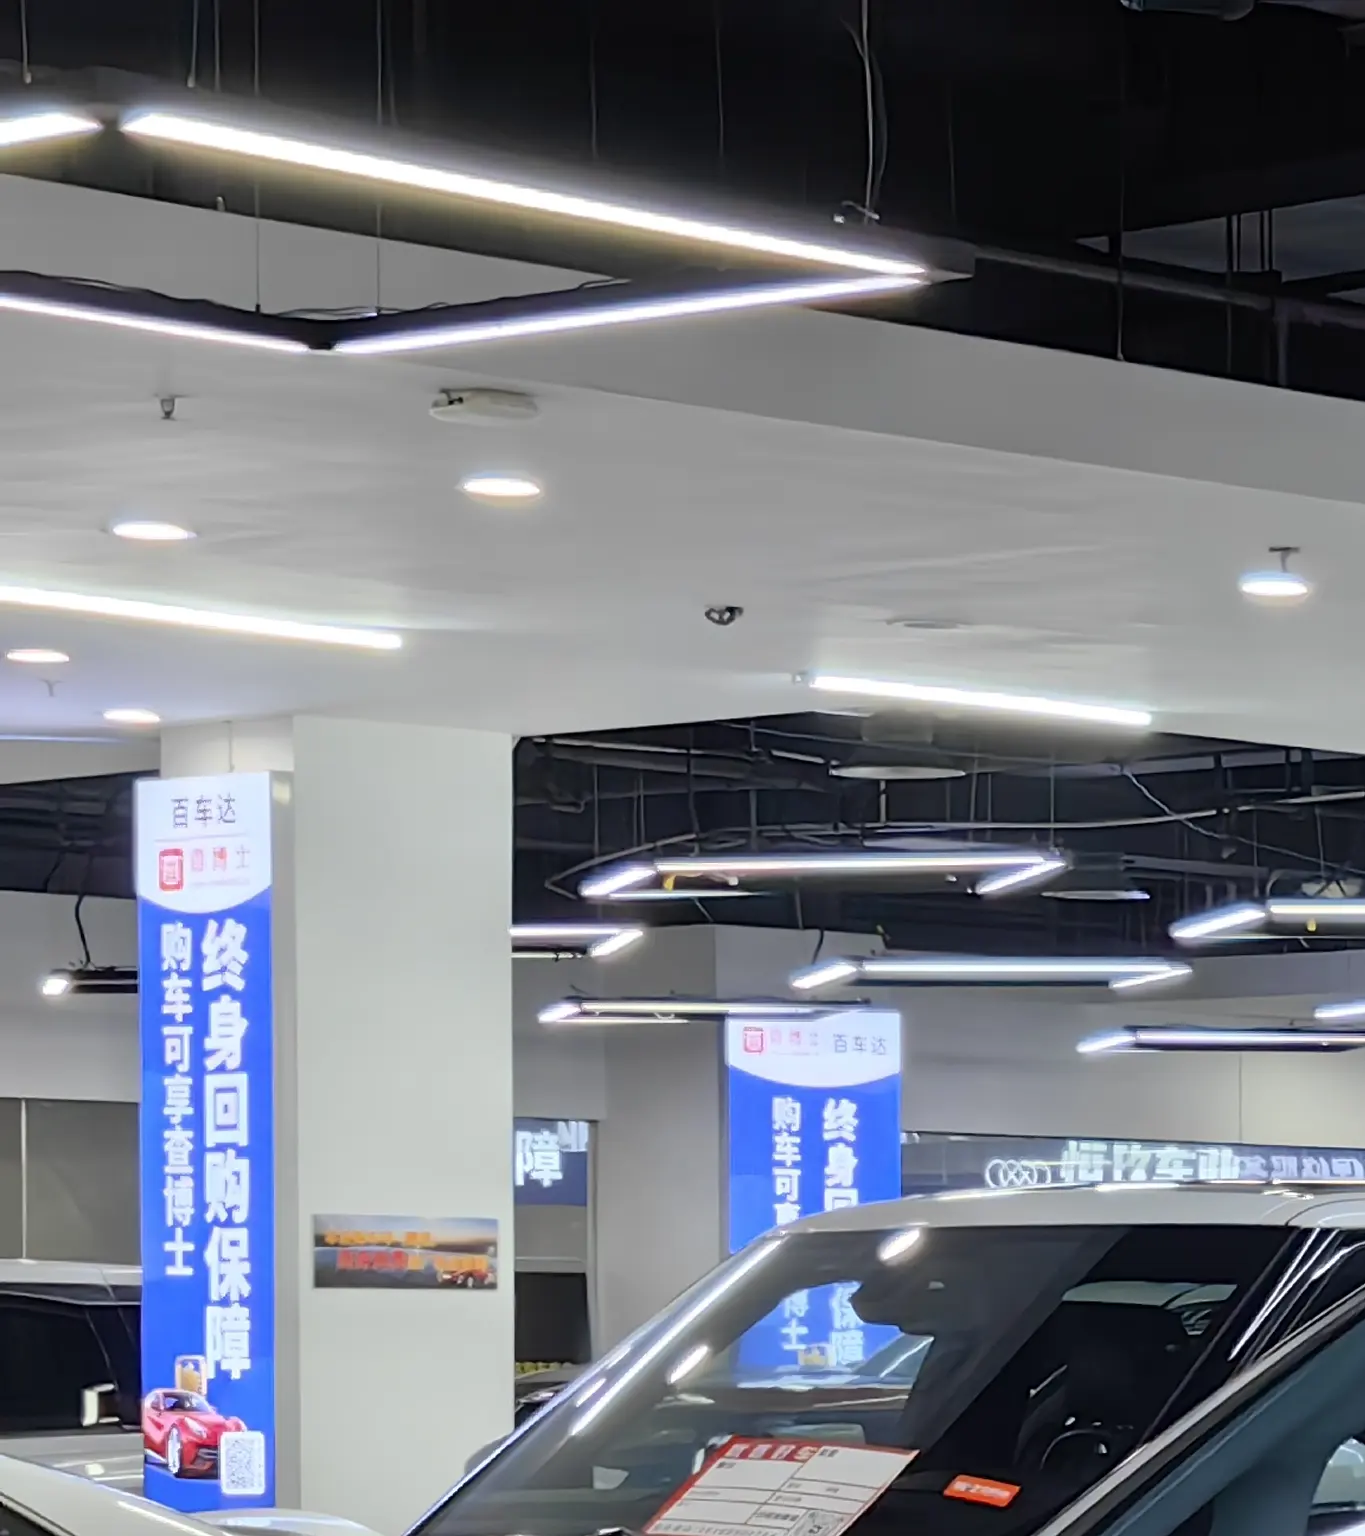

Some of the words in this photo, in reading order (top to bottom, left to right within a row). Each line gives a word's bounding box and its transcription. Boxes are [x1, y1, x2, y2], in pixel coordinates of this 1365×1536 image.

[171, 793, 237, 829] 百车达
[160, 921, 195, 1277] 购车可享查博士
[833, 1033, 888, 1056] 百车达
[201, 917, 253, 1381] 终身回购保障
